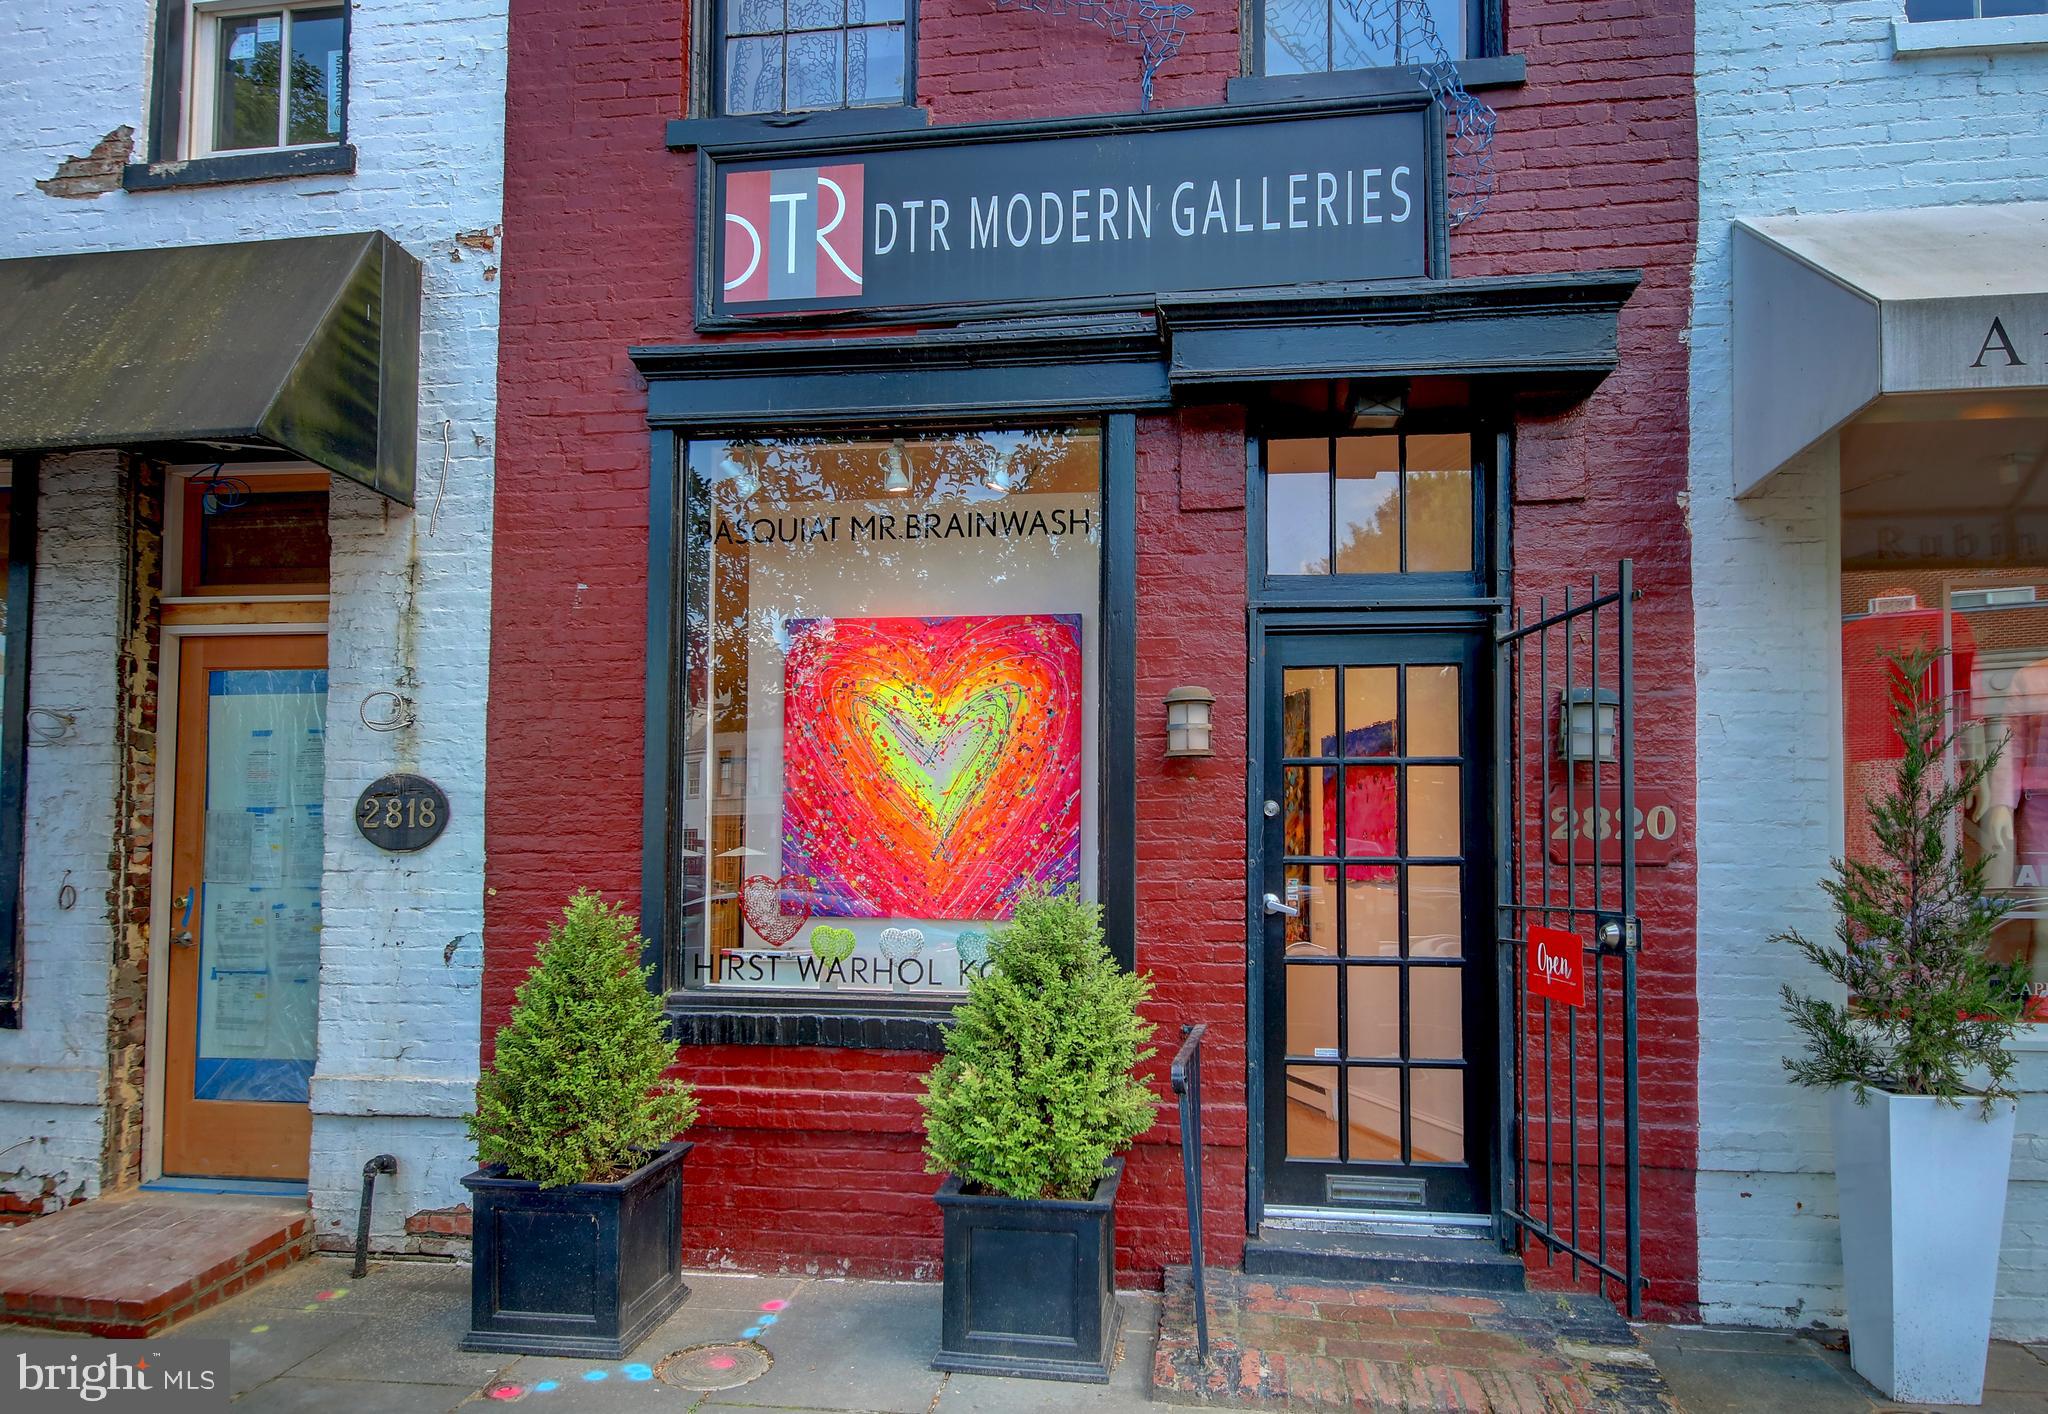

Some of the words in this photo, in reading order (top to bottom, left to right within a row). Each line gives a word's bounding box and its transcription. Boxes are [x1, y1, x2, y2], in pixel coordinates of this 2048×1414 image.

[874, 199, 951, 256] DTR
[969, 184, 1153, 251] MODERN
[1170, 165, 1412, 238] GALLERIES
[363, 797, 437, 828] 2818
[1550, 804, 1677, 841] 2820
[694, 953, 781, 981] HIRST
[797, 956, 943, 986] WARHOL
[1537, 942, 1572, 984] Open
